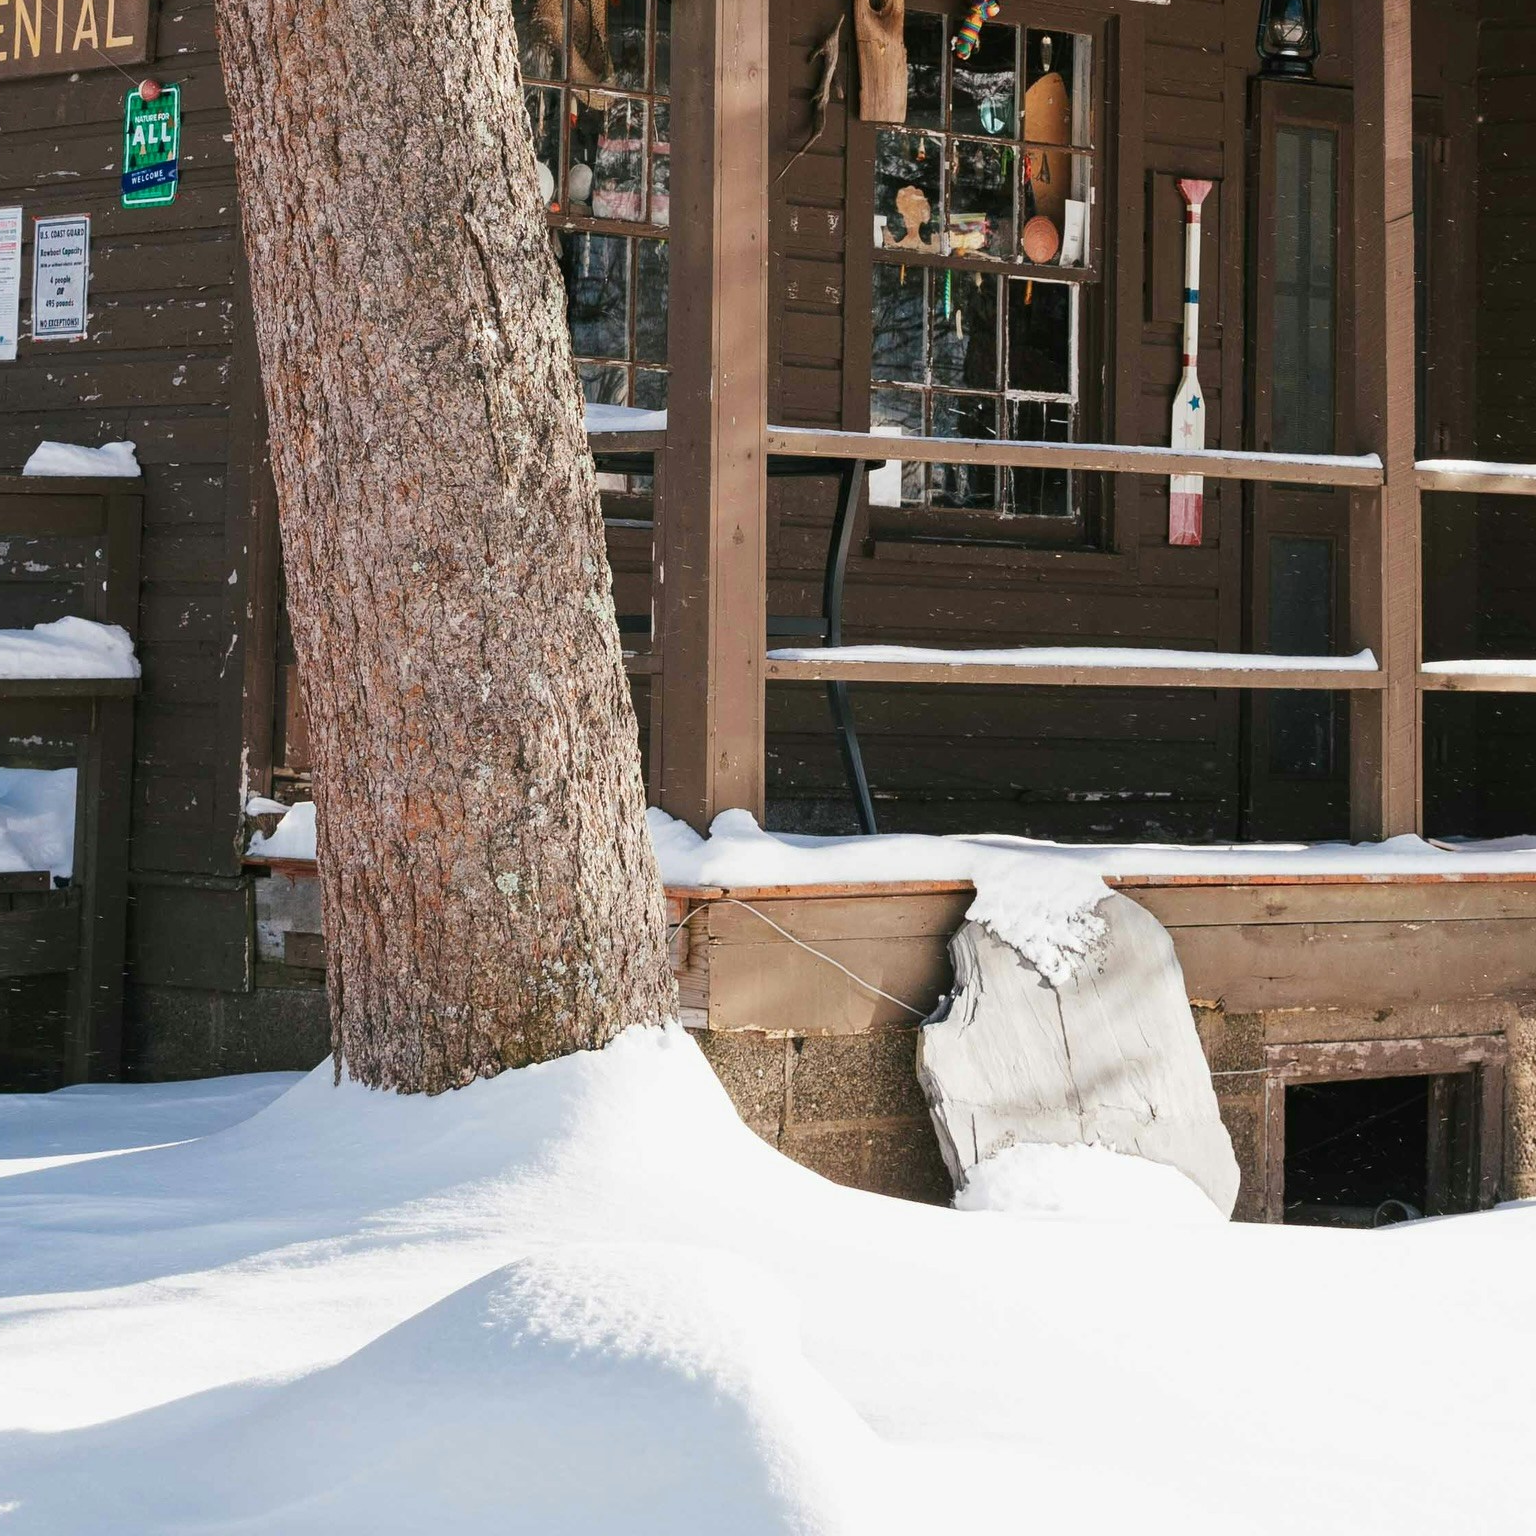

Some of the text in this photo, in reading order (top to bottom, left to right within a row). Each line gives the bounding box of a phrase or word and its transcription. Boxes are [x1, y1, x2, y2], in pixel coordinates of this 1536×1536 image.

[135, 112, 170, 123] NATURE FOR
[132, 122, 171, 146] ALL
[132, 169, 163, 184] WELCOME
[51, 229, 65, 239] COAST
[66, 227, 84, 237] GUARD
[62, 247, 82, 257] Capacity
[55, 275, 71, 286] people
